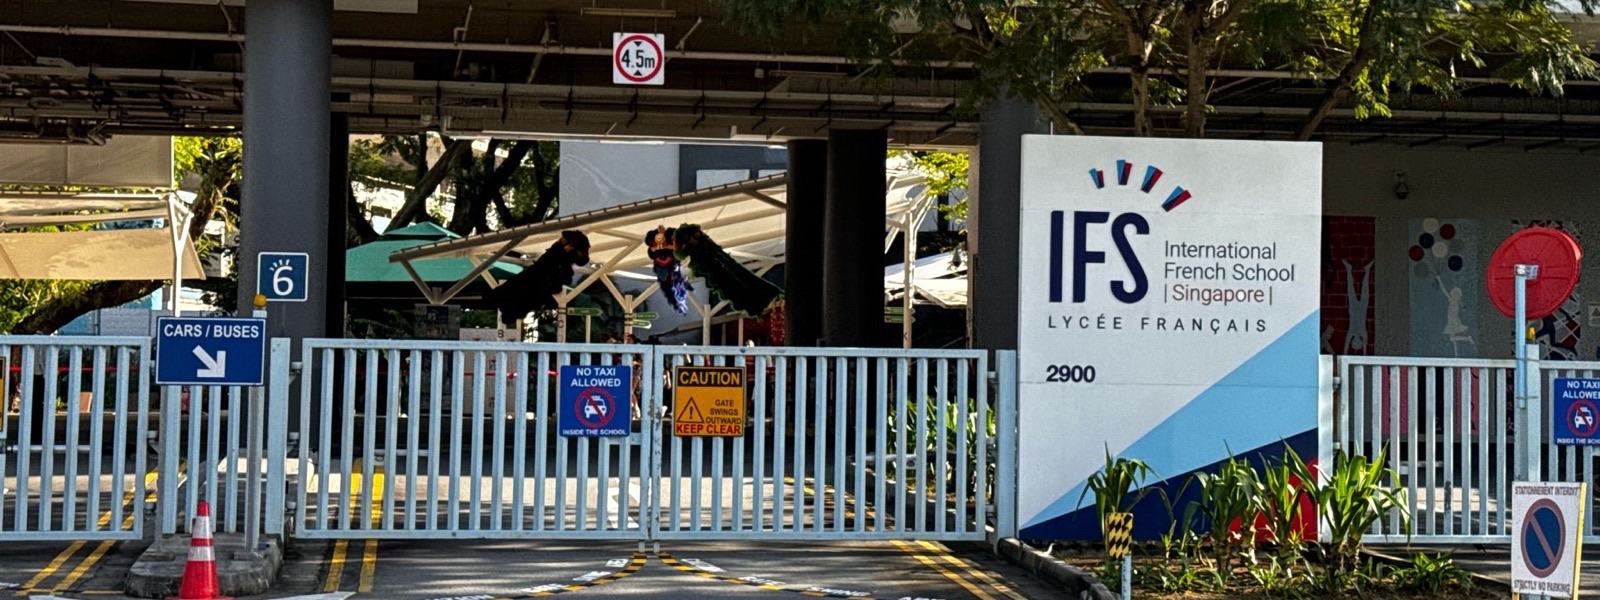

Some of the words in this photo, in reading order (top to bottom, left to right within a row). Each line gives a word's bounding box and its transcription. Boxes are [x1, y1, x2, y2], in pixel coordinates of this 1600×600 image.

[621, 49, 655, 68] 4.5m
[1049, 210, 1150, 304] IFS
[1164, 241, 1276, 260] International
[1164, 262, 1226, 280] French
[1232, 264, 1295, 282] School
[272, 265, 294, 296] 6
[1172, 284, 1265, 306] Singapore
[164, 324, 202, 337] CARS
[213, 325, 260, 338] BUSES
[1048, 314, 1123, 330] LYCÉE
[1141, 317, 1267, 335] FRANÇAIS
[576, 367, 592, 377] NO
[594, 367, 616, 377] TAXI
[679, 371, 740, 386] CAUTION
[1046, 364, 1096, 383] 2900
[570, 378, 621, 388] ALLOWED
[1567, 380, 1580, 389] NO
[1582, 380, 1600, 389] TAXI
[1562, 390, 1600, 400] ALLOWE
[715, 399, 734, 407] GATE
[709, 408, 738, 416] SWINGS
[705, 417, 742, 425] OUTWARD
[676, 424, 703, 434] KEEP
[706, 424, 741, 435] CLEAR
